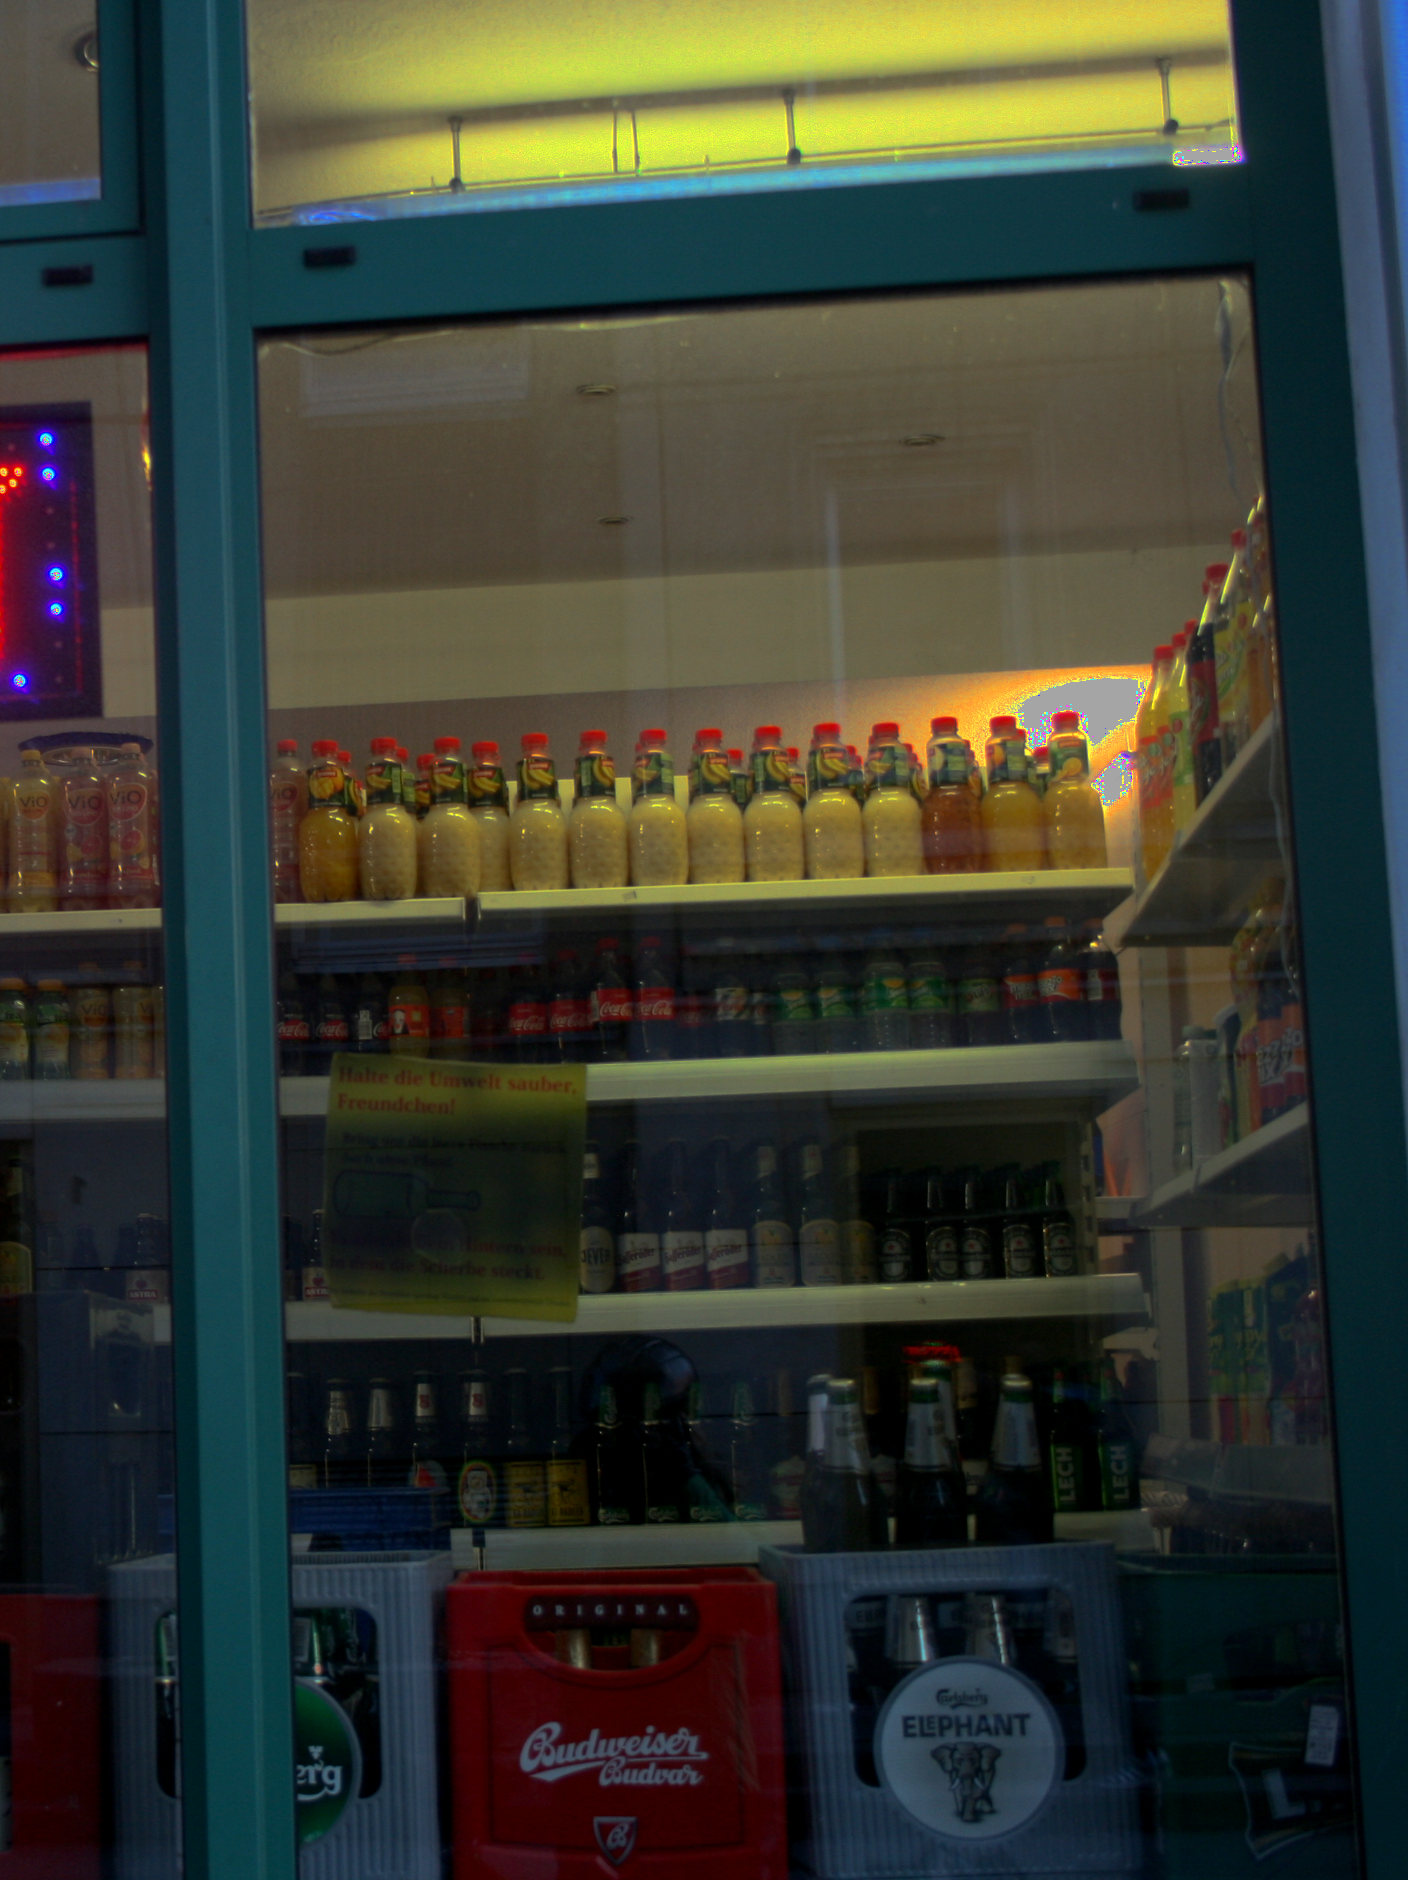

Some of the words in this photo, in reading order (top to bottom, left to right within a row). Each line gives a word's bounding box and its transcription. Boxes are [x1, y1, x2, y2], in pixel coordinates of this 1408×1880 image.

[338, 1067, 389, 1085] Halte
[395, 1070, 423, 1087] die
[430, 1071, 501, 1090] Umwelt
[508, 1076, 577, 1095] sauber,
[337, 1094, 456, 1116] Freundchen!
[1055, 1446, 1074, 1501] LECH
[1109, 1445, 1130, 1500] LECH
[532, 1602, 689, 1617] ORIGINAL
[901, 1713, 1031, 1738] ELEPHANT
[519, 1720, 709, 1779] Budweiser
[295, 1762, 343, 1797] erg
[599, 1756, 704, 1786] Budvar
